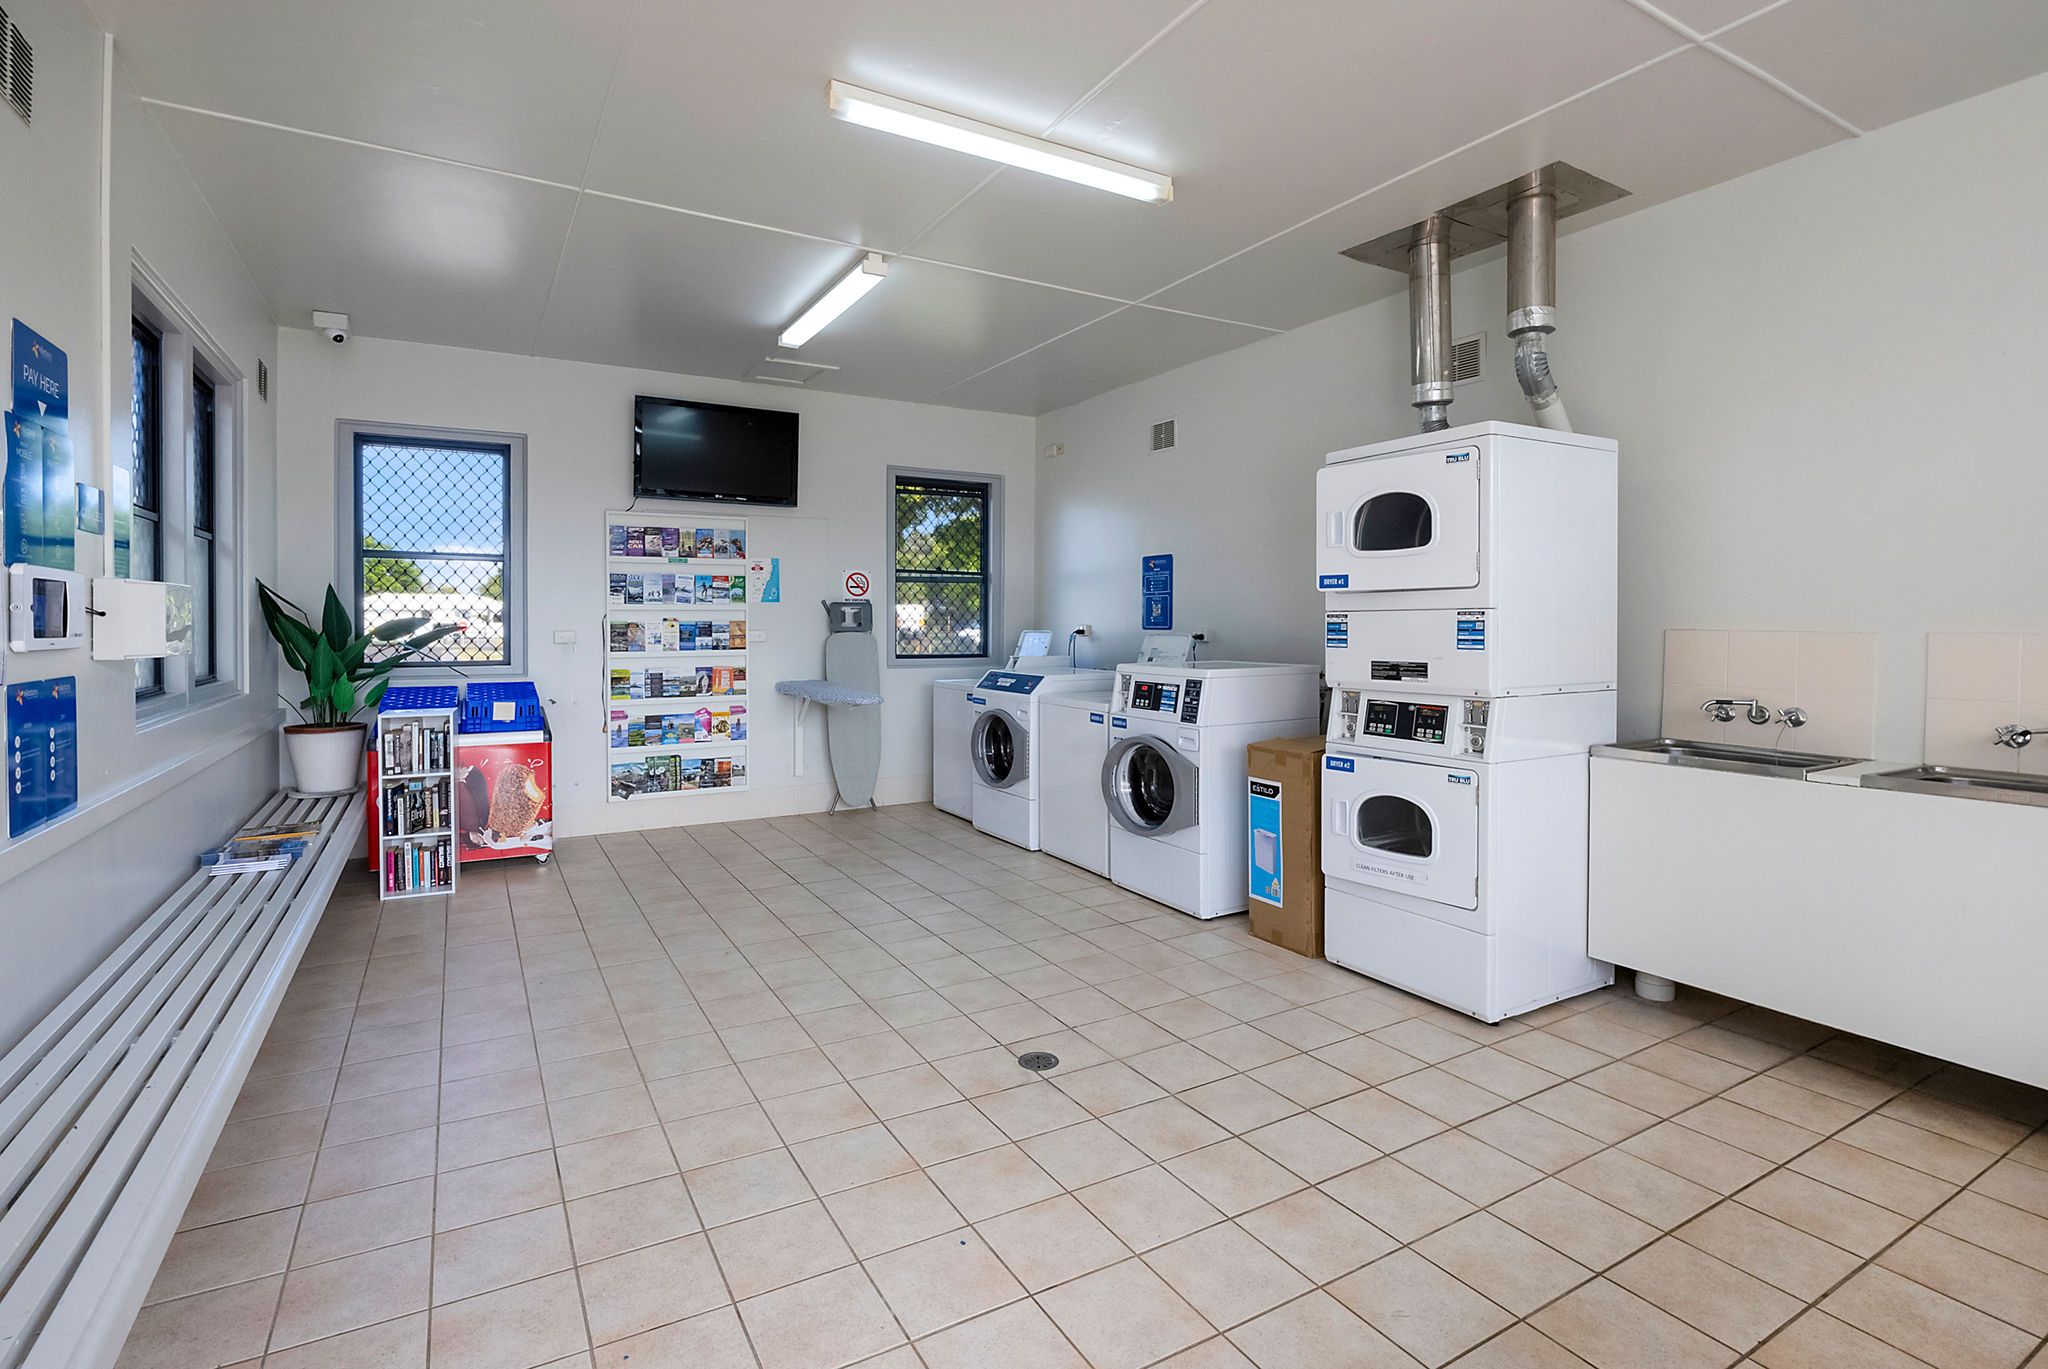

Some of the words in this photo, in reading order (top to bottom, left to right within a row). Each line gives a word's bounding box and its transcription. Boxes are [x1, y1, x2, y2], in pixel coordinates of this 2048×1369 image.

[23, 363, 39, 387] PAY
[40, 374, 60, 399] HERE
[1356, 863, 1370, 871] CLEAN
[1371, 867, 1389, 875] FILTERS
